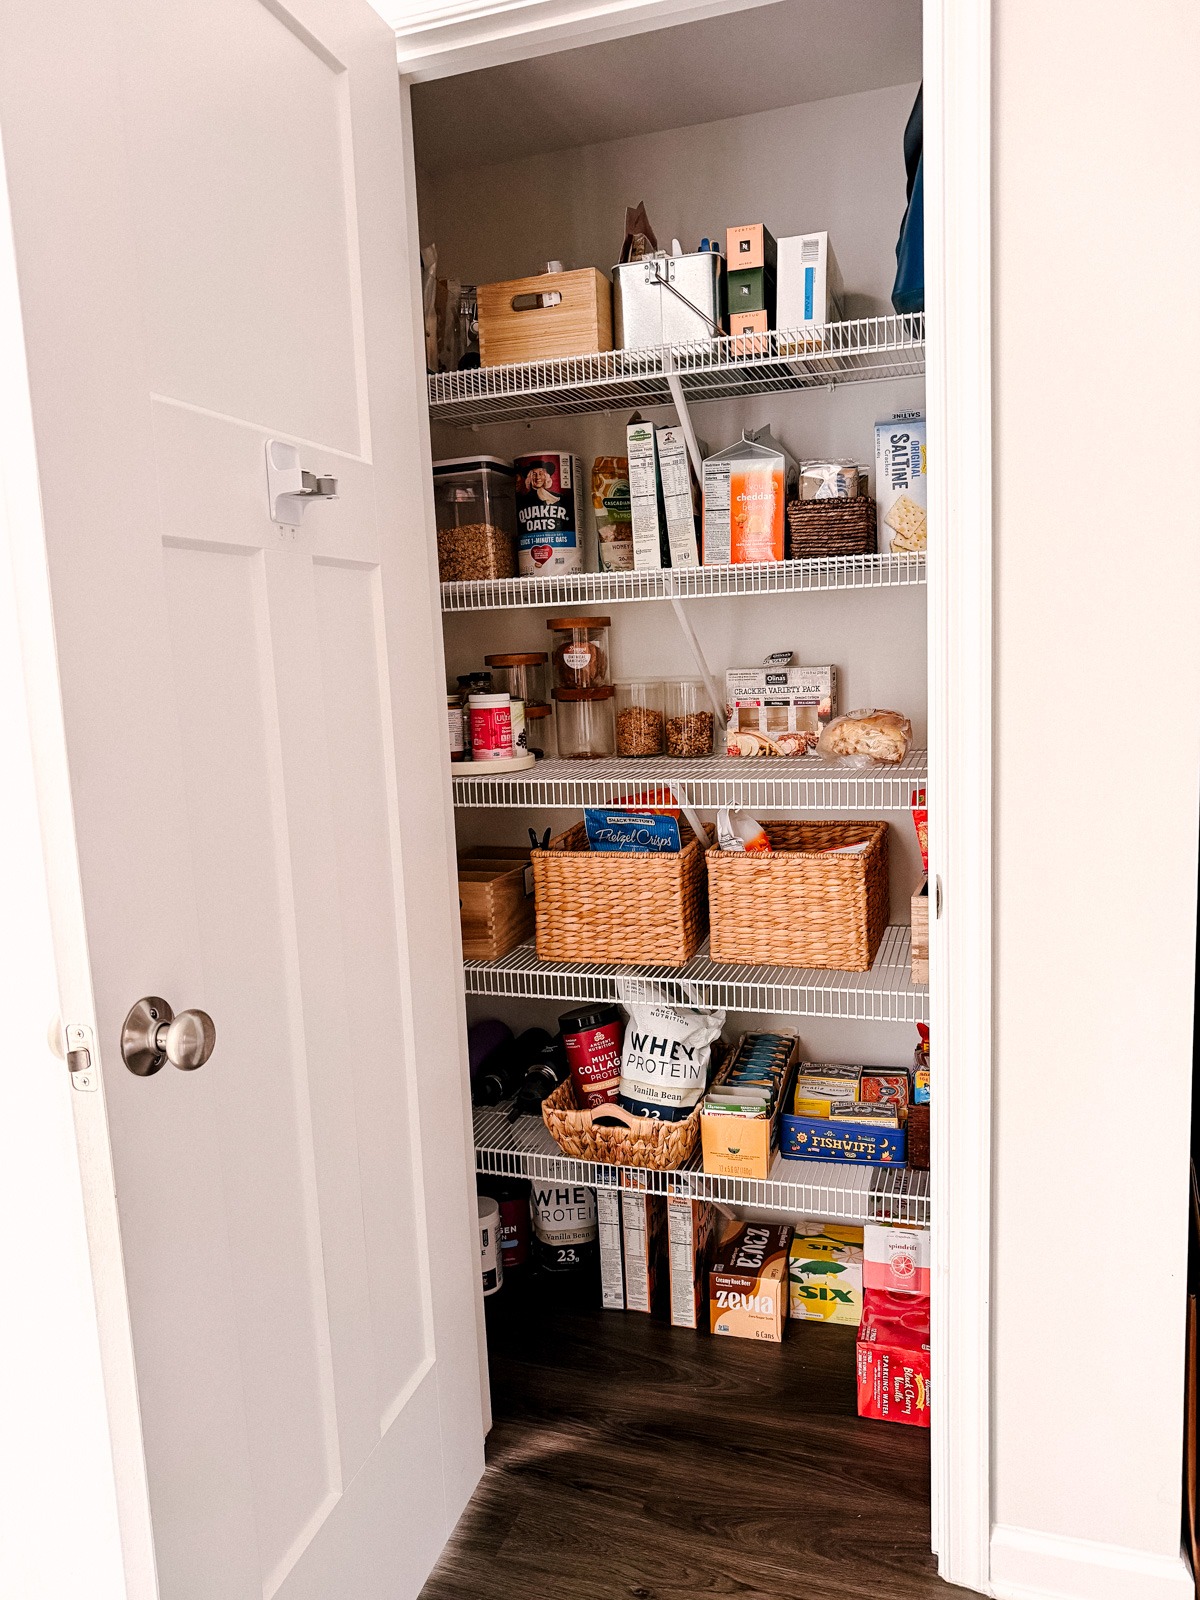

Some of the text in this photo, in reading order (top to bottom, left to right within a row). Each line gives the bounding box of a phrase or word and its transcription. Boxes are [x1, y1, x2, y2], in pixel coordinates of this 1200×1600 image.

[892, 411, 921, 419] SALTINE
[890, 433, 910, 491] SALTINE
[910, 440, 920, 480] ORIGINAL
[736, 492, 774, 502] cheddar
[519, 505, 567, 523] QUAKER
[526, 519, 556, 531] OATS
[531, 536, 554, 544] 1-MINUTE
[734, 685, 821, 695] CRACKER VARIETY PACK
[595, 828, 672, 851] Pretzel Crisps
[650, 1011, 689, 1027] NUTRITION
[588, 1041, 615, 1052] NUTRITION
[590, 1038, 611, 1048] ANCIENT
[631, 1031, 696, 1062] WHEY
[591, 1050, 617, 1064] MULTI
[578, 1057, 621, 1075] COLLAG
[626, 1053, 701, 1080] PROTEIN
[590, 1068, 621, 1081] PROTEI
[633, 1084, 659, 1098] Vanilla
[660, 1089, 683, 1101] Bean
[640, 1107, 661, 1120] 23
[812, 1136, 876, 1154] FISHWIFE
[535, 1207, 592, 1222] ROTEI
[807, 1243, 845, 1252] SIX
[888, 1243, 917, 1251] spindrift
[715, 1276, 731, 1286] Creamy
[716, 1290, 774, 1314] zevia
[798, 1286, 854, 1303] SIX
[755, 1330, 775, 1340] 6 Cans
[894, 1376, 905, 1403] Vanilla
[901, 1366, 914, 1415] Black Cherry
